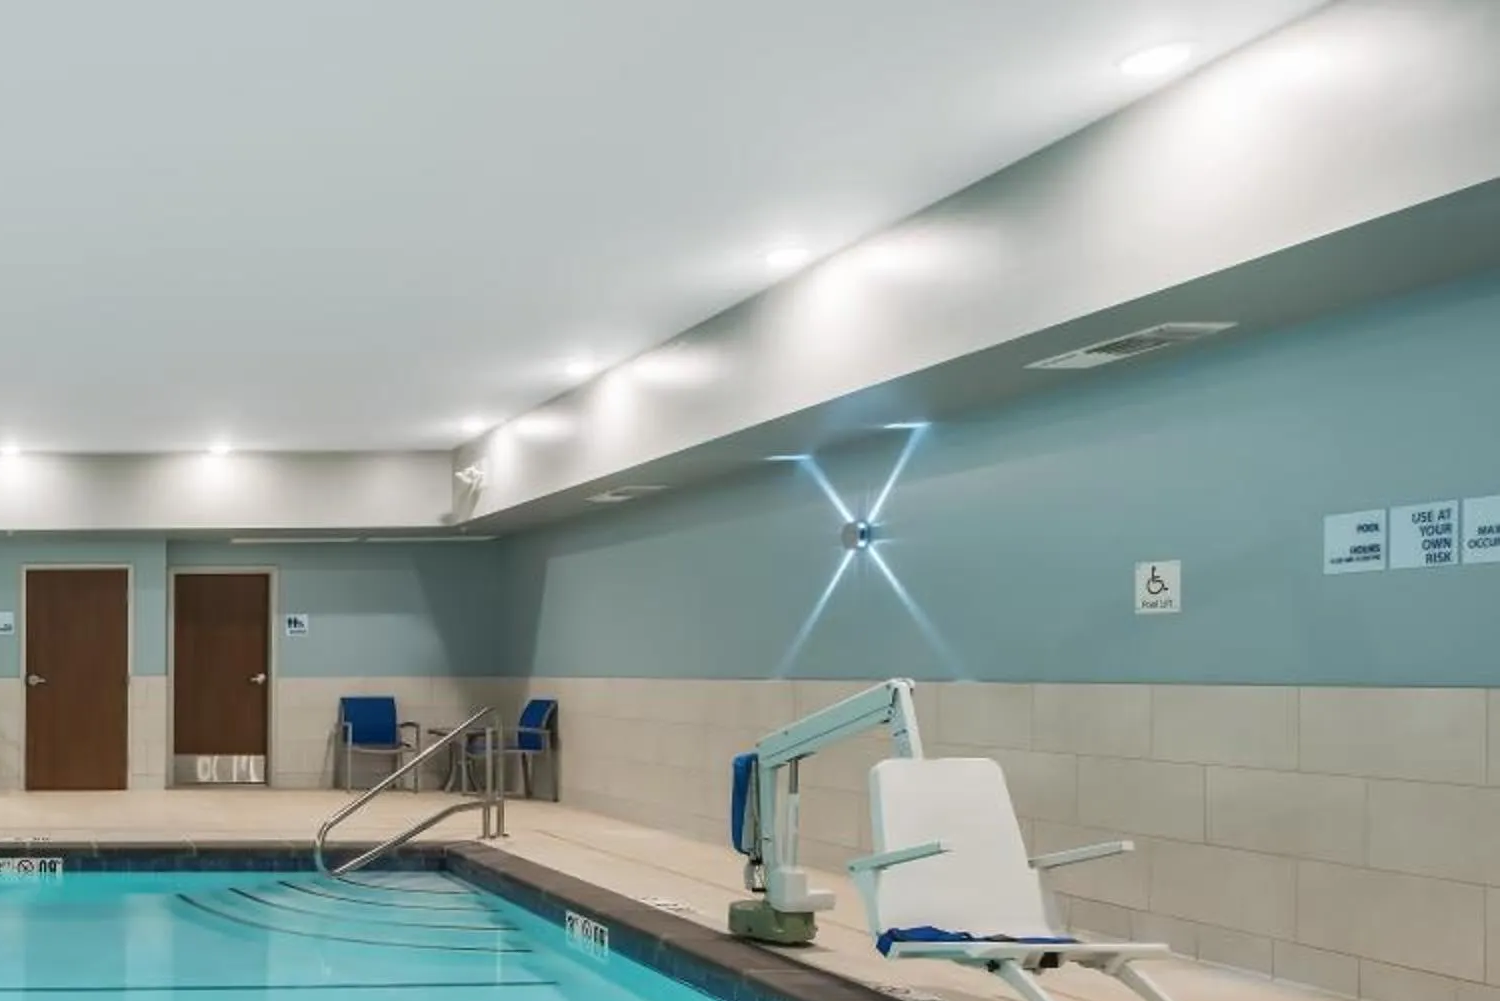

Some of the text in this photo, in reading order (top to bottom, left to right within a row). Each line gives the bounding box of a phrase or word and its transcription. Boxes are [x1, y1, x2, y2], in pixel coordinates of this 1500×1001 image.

[1411, 508, 1452, 523] USE AT
[1419, 523, 1452, 536] YOUR
[1421, 537, 1452, 550] OWN
[1425, 552, 1451, 564] RISK
